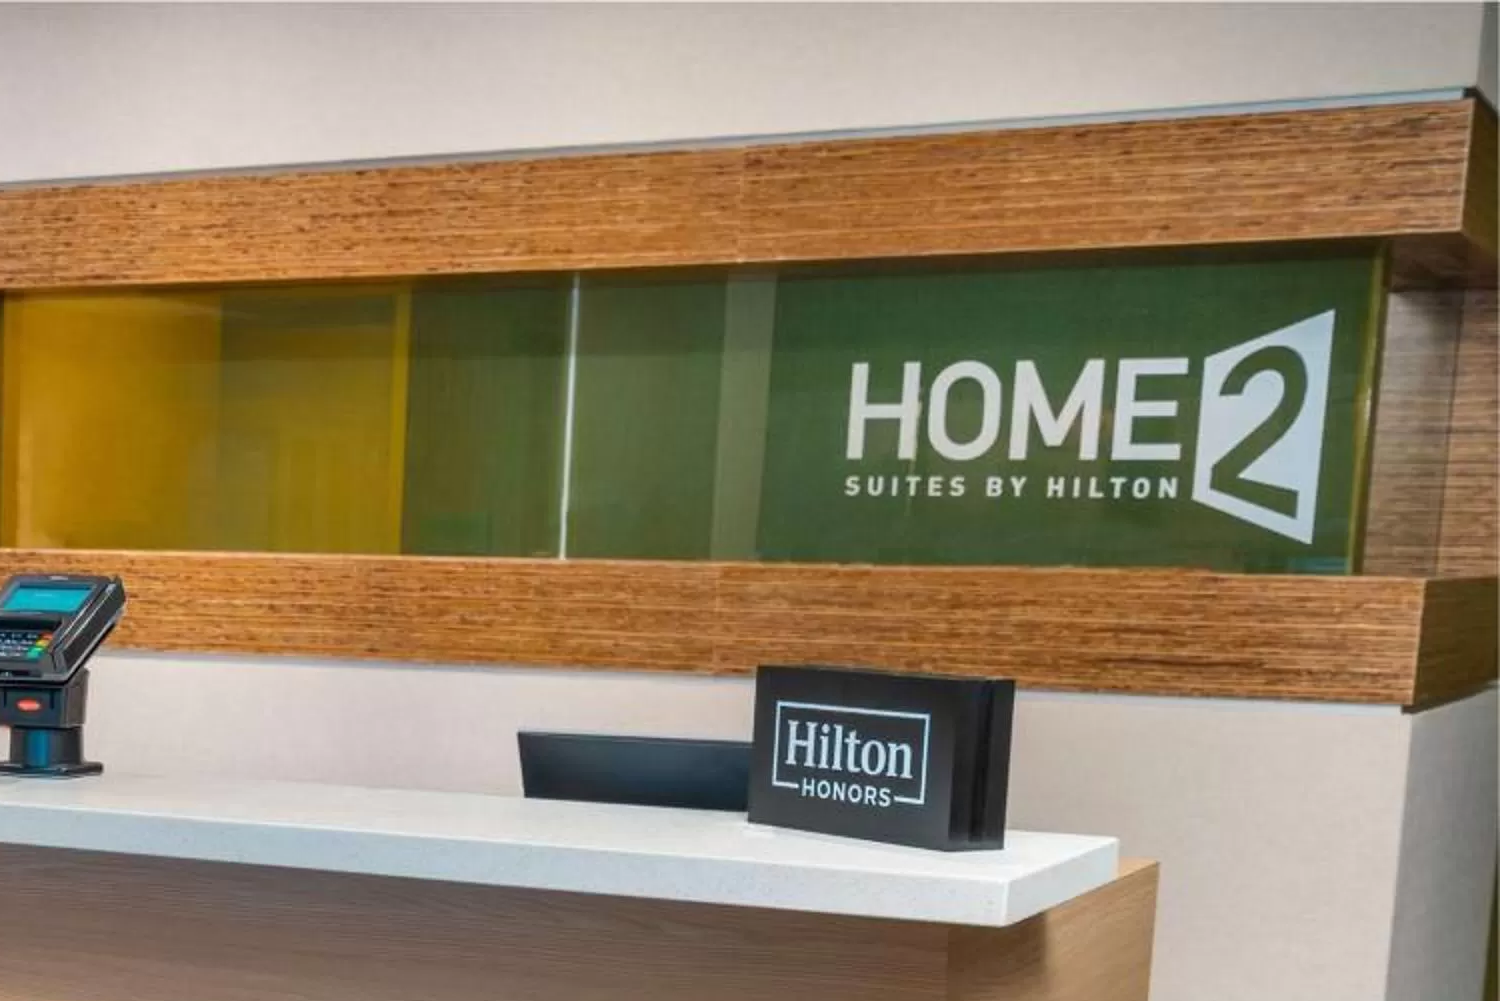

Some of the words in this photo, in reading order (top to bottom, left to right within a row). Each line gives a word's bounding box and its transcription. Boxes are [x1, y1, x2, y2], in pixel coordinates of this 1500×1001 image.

[844, 474, 967, 498] SUITES
[986, 475, 1028, 498] BY
[1046, 476, 1179, 500] HILTON
[784, 719, 913, 780] Hilton
[801, 777, 892, 808] HONORS
